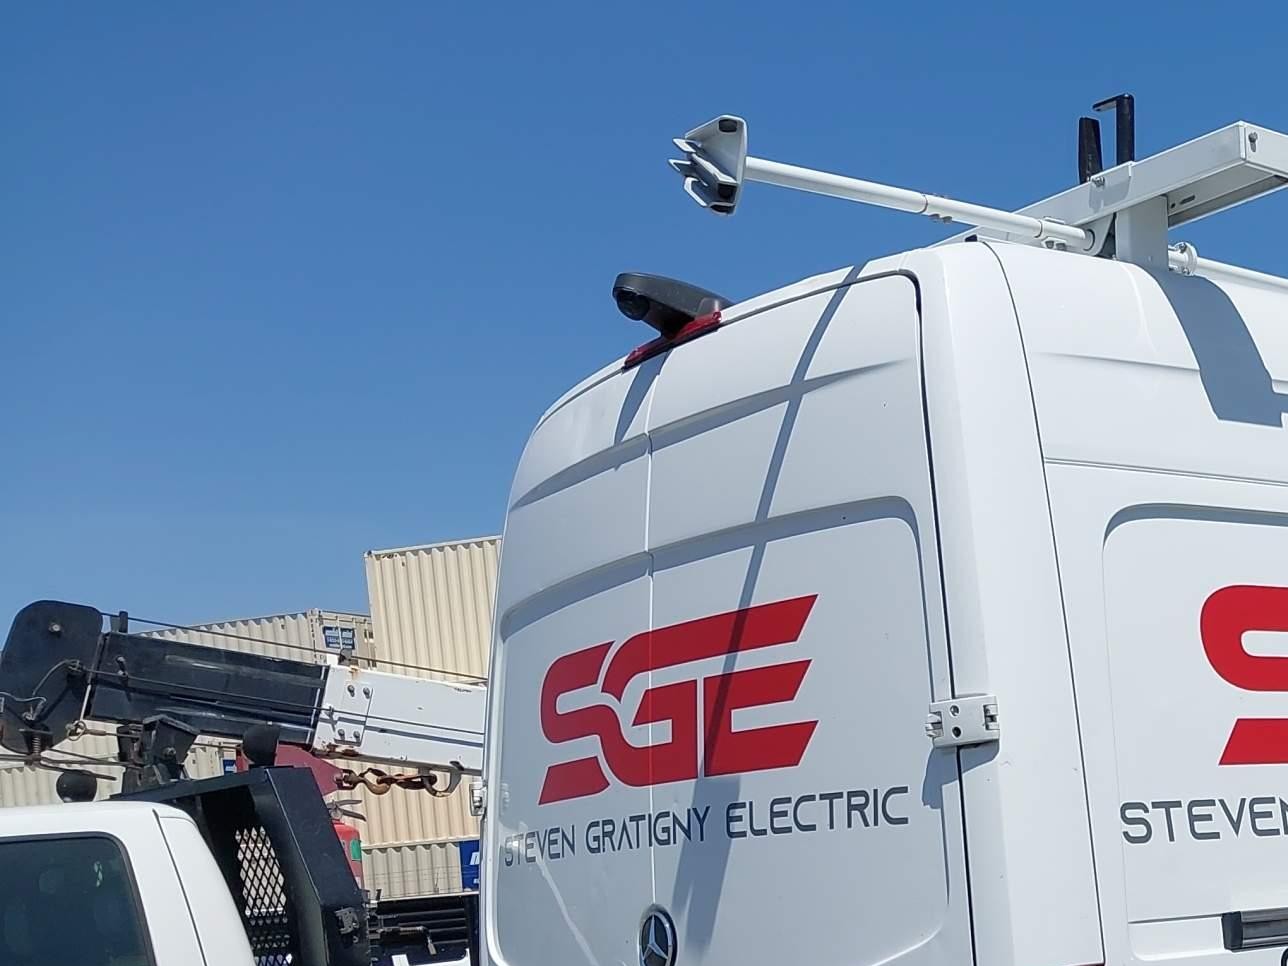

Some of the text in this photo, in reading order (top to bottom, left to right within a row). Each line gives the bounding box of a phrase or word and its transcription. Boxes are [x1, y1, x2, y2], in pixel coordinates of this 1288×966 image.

[538, 594, 819, 805] SGE
[503, 785, 909, 867] STEVEN GRATIGNY ELECTRIC
